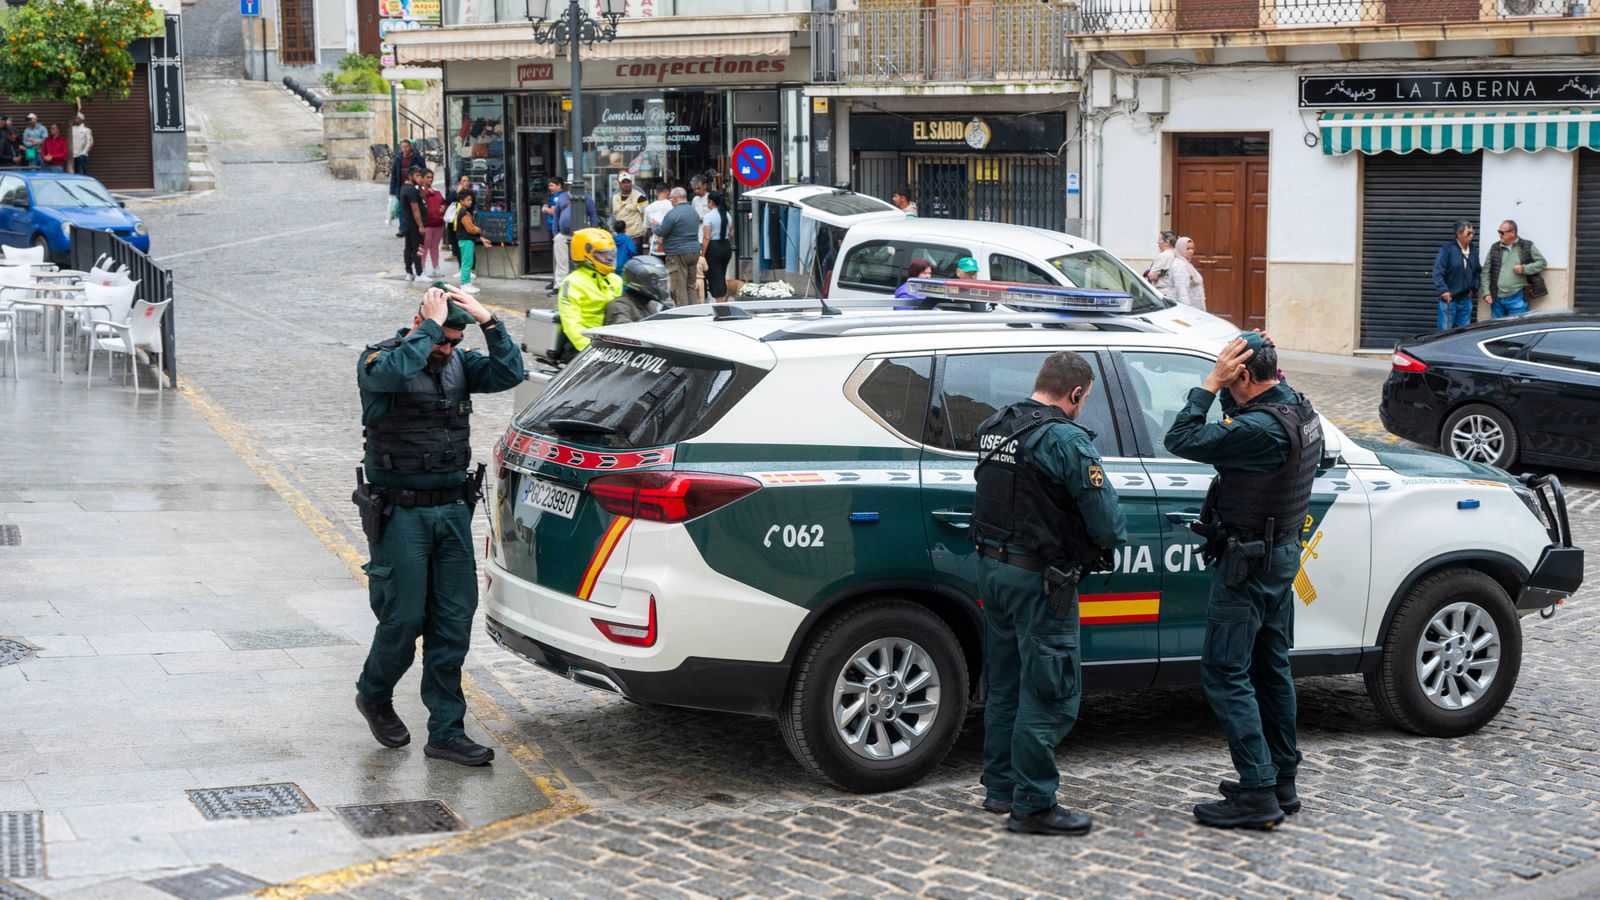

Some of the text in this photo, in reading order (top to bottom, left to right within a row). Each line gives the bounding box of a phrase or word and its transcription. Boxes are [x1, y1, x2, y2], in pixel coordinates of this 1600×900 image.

[615, 57, 786, 83] confecciones
[1396, 82, 1422, 98] LA
[1433, 80, 1537, 98] TABERNA
[602, 108, 645, 123] Comercial
[667, 134, 700, 142] ACEITUNAS
[913, 121, 964, 140] EL SABIO
[582, 346, 667, 374] GUARDIA CIVIL
[1000, 454, 1017, 465] CIVIL
[1401, 478, 1438, 486] GUARDIA
[783, 524, 824, 548] 062
